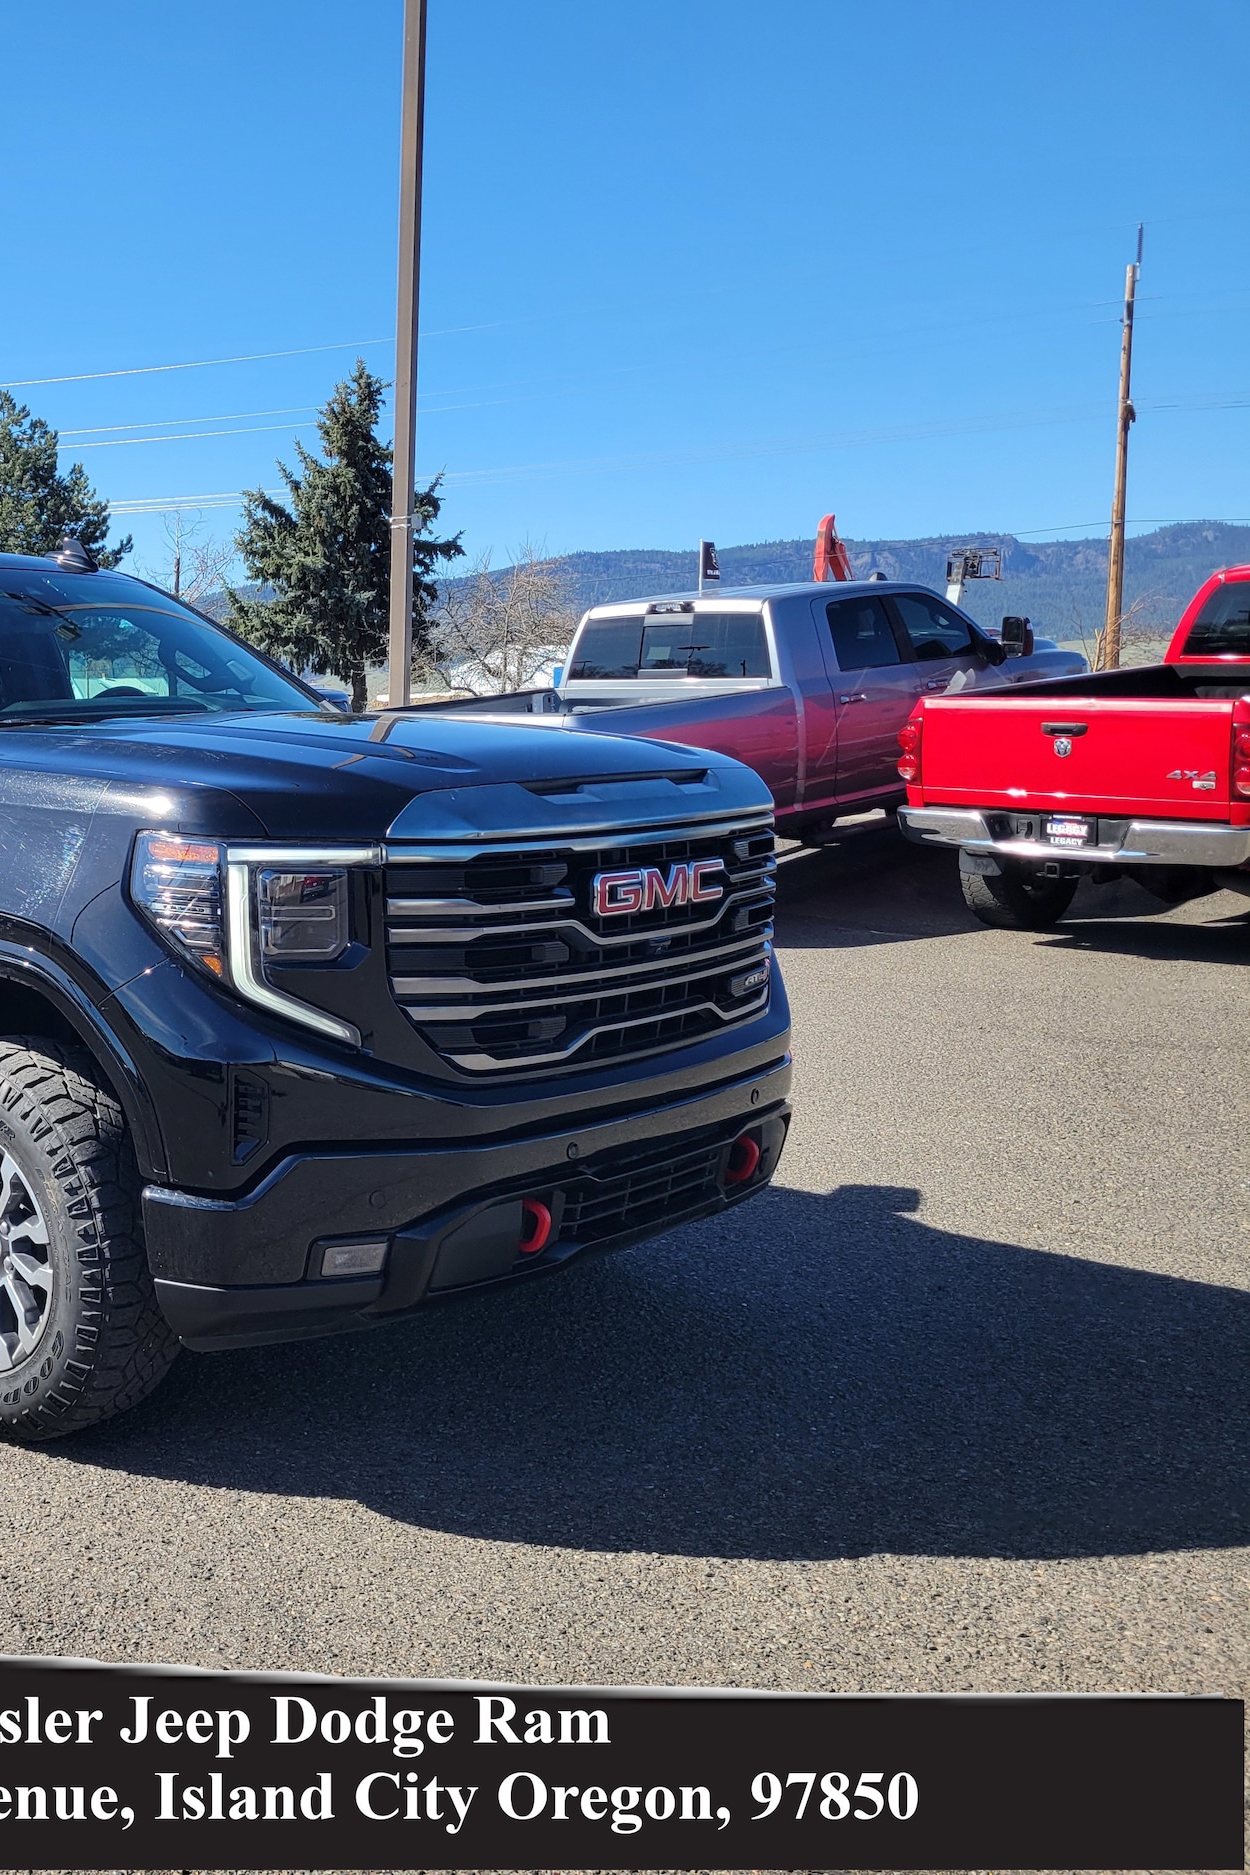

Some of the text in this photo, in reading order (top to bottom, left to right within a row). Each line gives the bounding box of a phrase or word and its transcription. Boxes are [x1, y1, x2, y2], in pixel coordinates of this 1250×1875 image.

[1046, 822, 1089, 837] LEGACY
[1050, 836, 1083, 846] LEGACY
[593, 858, 725, 916] GMC
